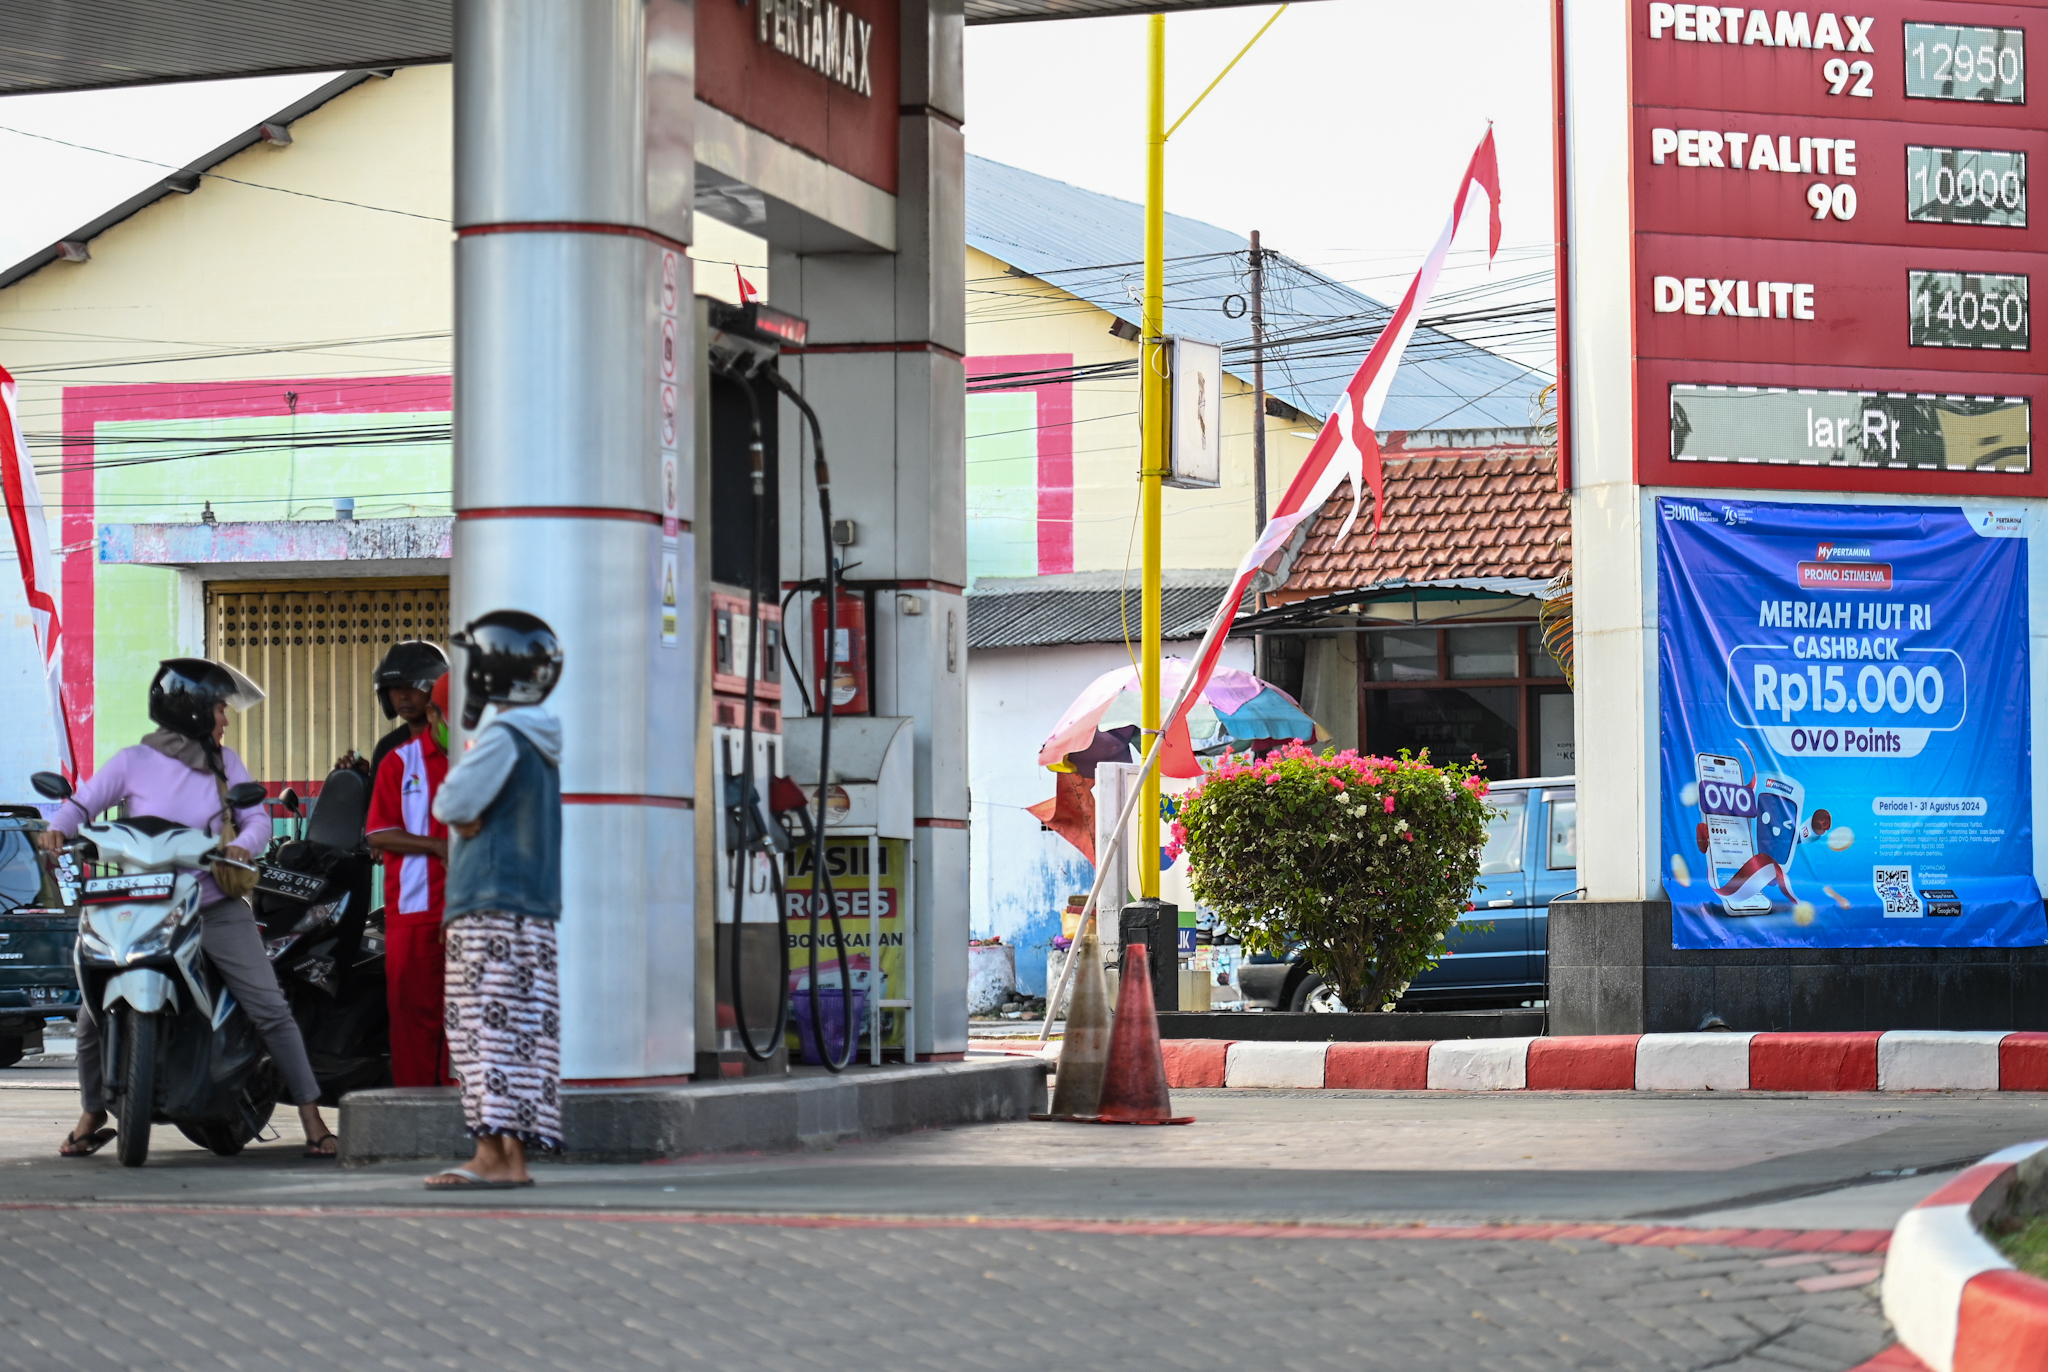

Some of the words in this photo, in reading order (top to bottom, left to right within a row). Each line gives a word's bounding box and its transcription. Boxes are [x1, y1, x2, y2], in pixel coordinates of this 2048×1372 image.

[1649, 2, 1875, 53] PERTAMAX
[1823, 58, 1874, 97] 92
[1912, 42, 2018, 85] 12950
[1652, 128, 1857, 176] PERTALITE
[1807, 182, 1857, 221] 90
[1914, 166, 2020, 208] 10000
[1654, 275, 1815, 320] DEXLITE
[1916, 290, 2023, 331] 14050
[1804, 568, 1840, 581] PROMO
[1841, 569, 1885, 582] ISTIMEWA
[1758, 600, 1851, 629] MERIAH
[1858, 602, 1905, 630] HUT
[1910, 604, 1931, 630] RI
[1792, 635, 1899, 661] CASHBACK
[1754, 664, 1944, 723] Rp15.000
[1790, 729, 1839, 752] OVO
[1844, 727, 1901, 753] Points
[1704, 784, 1751, 812] OVO
[1879, 801, 1908, 811] Periode
[1909, 801, 1913, 810] 1
[1920, 802, 1927, 810] 31
[1929, 801, 1960, 812] Agustus
[1961, 802, 1980, 810] 2024
[90, 882, 98, 891] P
[107, 878, 140, 890] 6254
[263, 869, 293, 883] 2585
